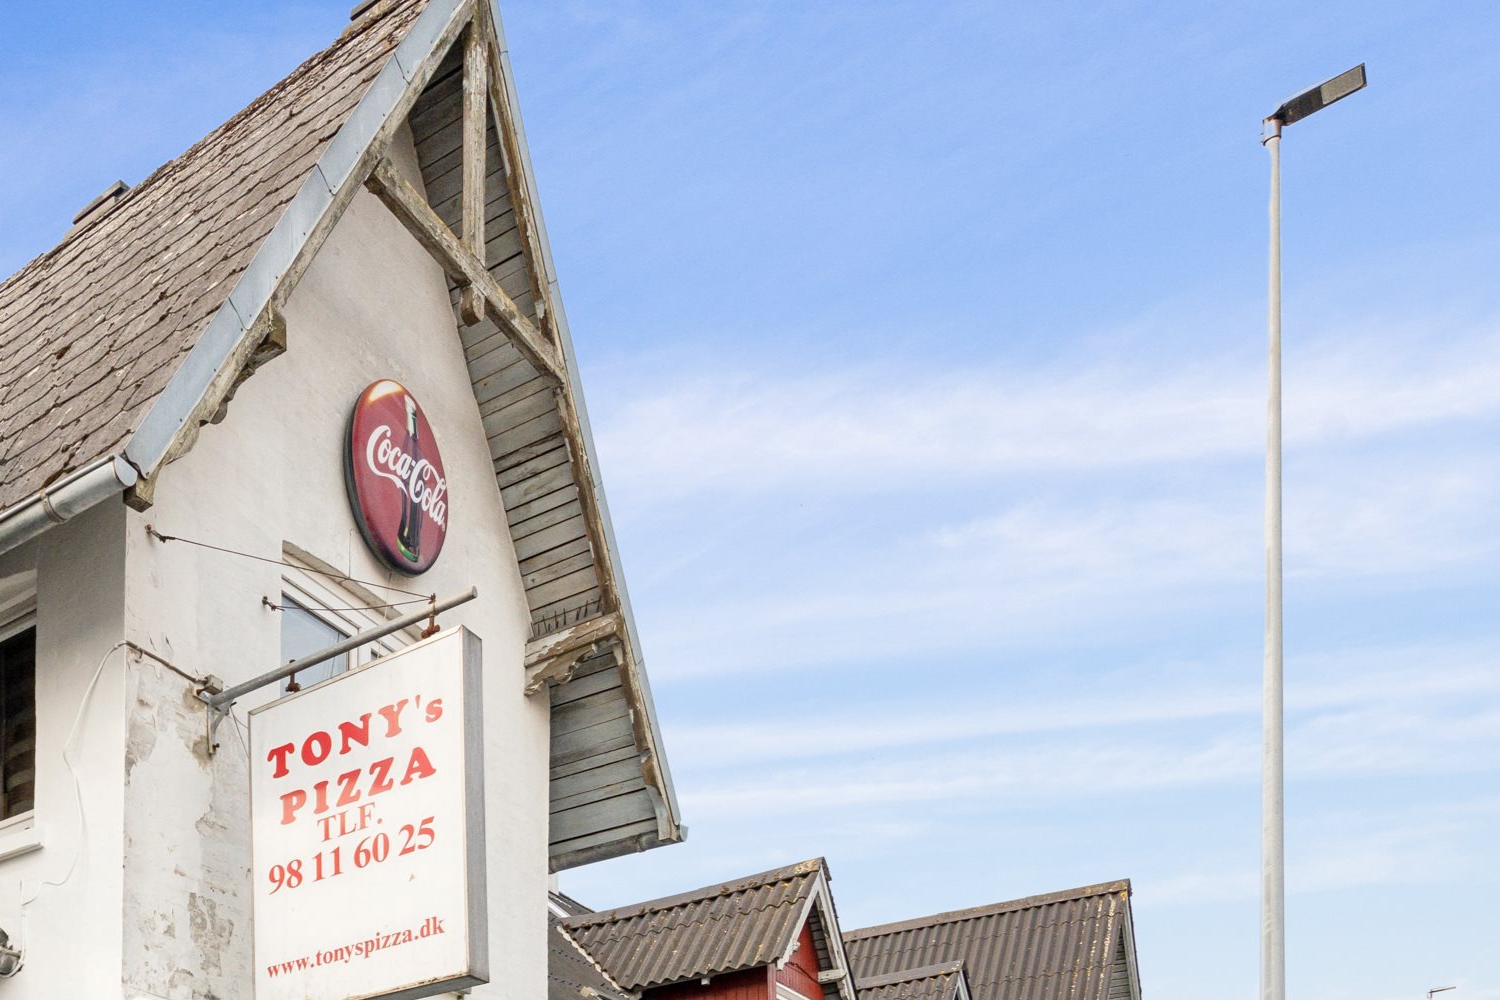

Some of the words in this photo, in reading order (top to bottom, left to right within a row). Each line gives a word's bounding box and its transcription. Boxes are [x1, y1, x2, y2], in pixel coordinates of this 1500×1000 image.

[367, 425, 447, 527] Coca-Cola
[267, 694, 444, 779] TONY's
[279, 747, 437, 825] PIZZA
[317, 802, 383, 842] TLF.
[268, 859, 303, 895] 98
[313, 847, 342, 882] 11
[353, 832, 389, 868] 60
[398, 816, 436, 855] 25
[267, 916, 445, 978] www.tonyspizza.dk
